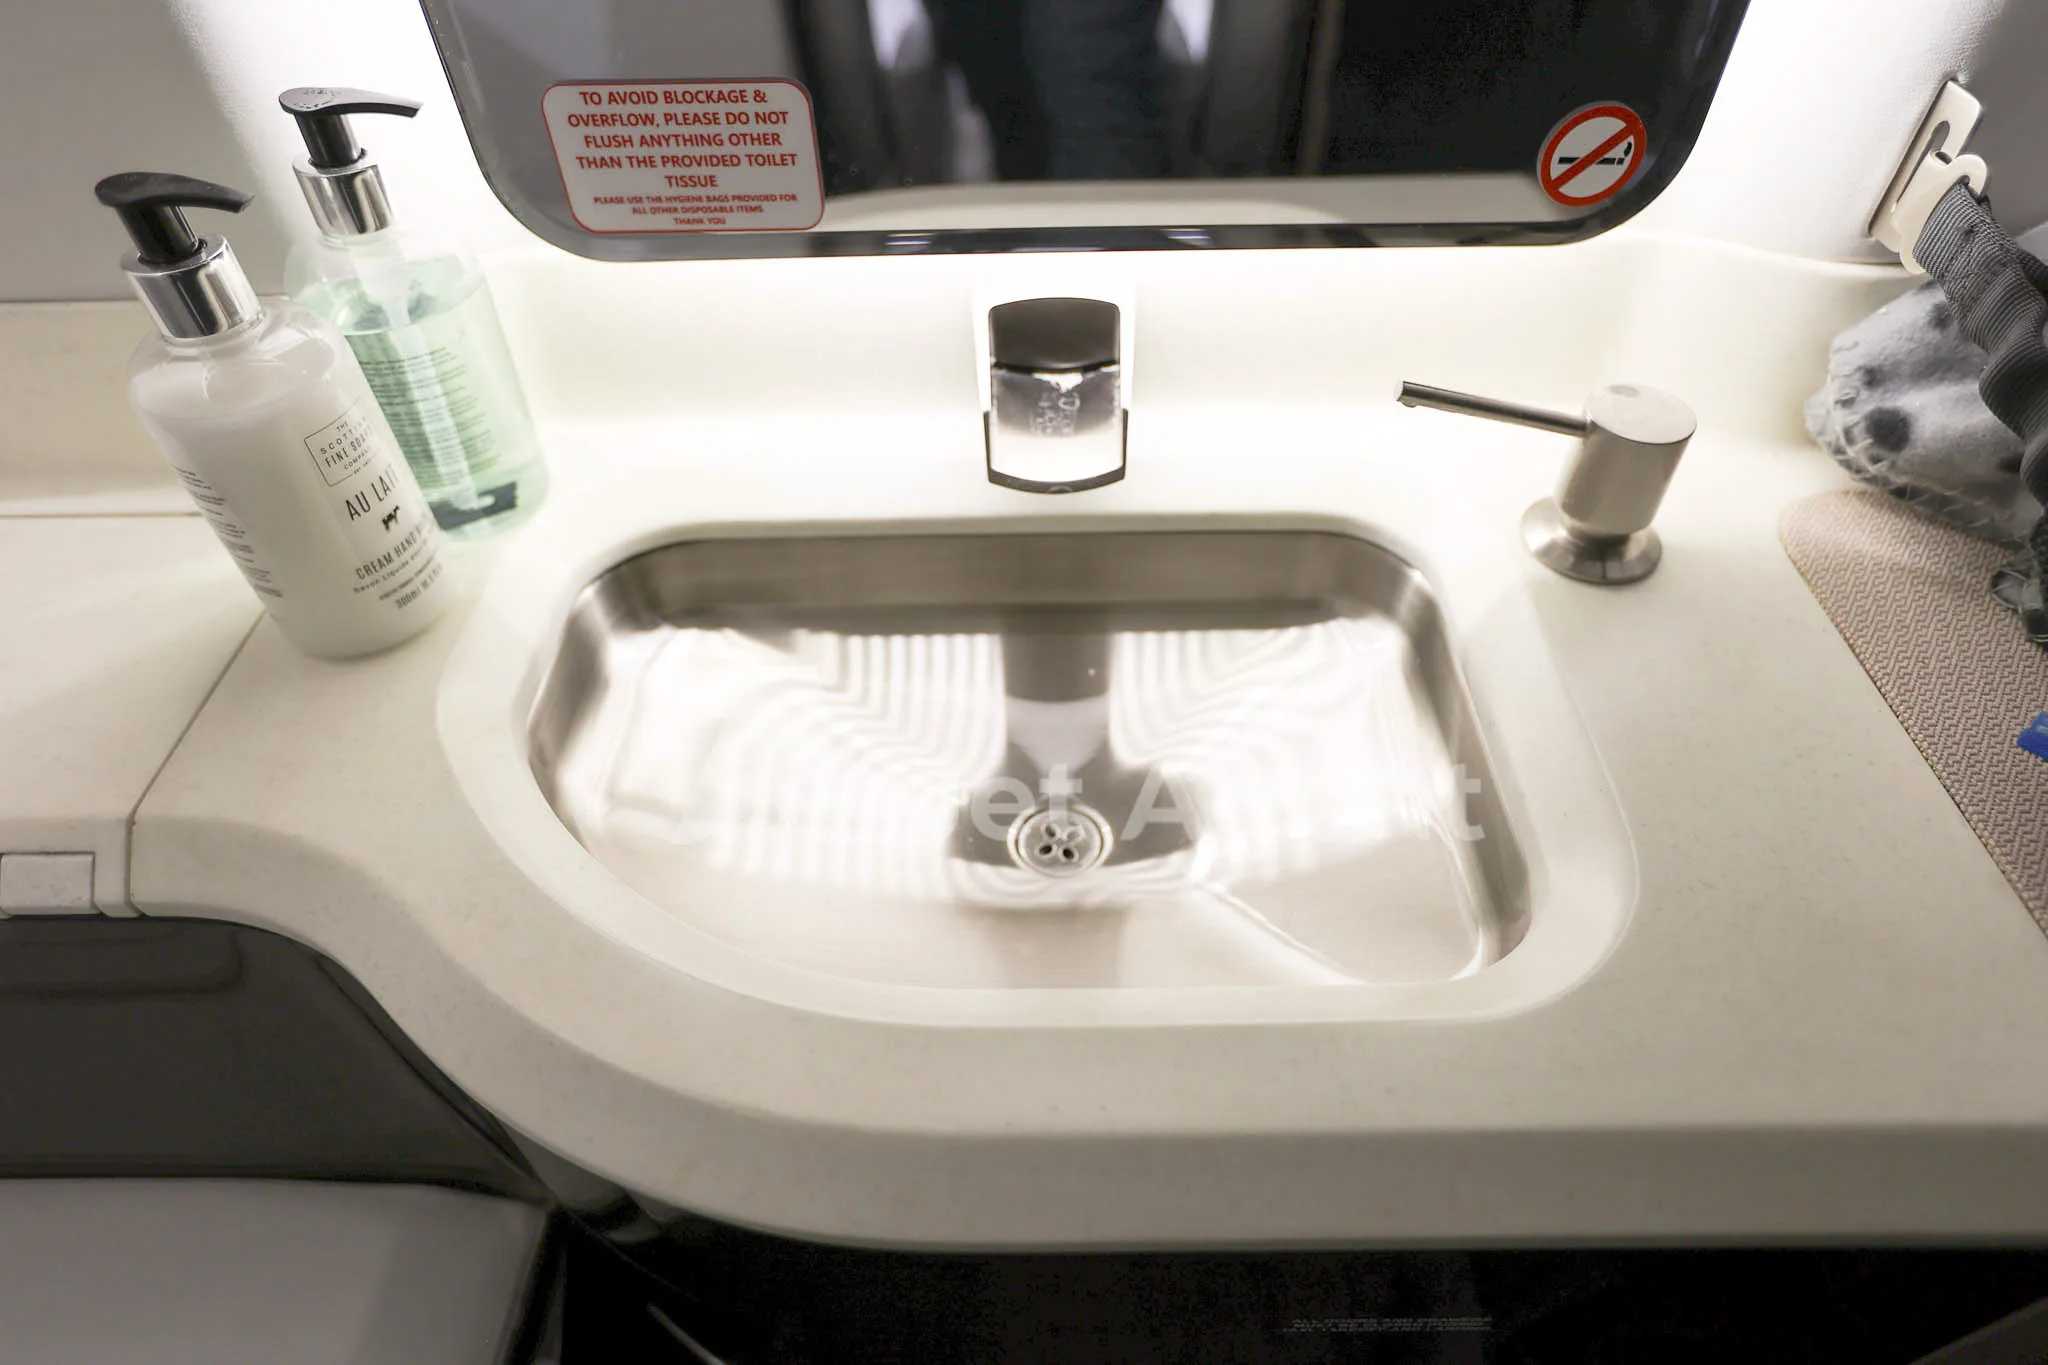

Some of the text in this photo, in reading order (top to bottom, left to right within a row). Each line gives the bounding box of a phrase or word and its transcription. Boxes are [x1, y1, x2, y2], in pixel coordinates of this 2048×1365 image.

[579, 89, 767, 105] TO AVOID BLOCKAGE &
[568, 111, 788, 128] OVERFLOW, PLEASE DO NOT
[584, 132, 782, 148] FLUSH ANYTHING OTHER
[576, 153, 798, 169] THAN THE PROVIDED TOILET
[665, 175, 718, 188] TISSUE
[593, 193, 797, 205] PLEASE USE THE HYGIENE BAGS PROVIDED FOR
[632, 205, 764, 215] ALL OTHER DISPOSABLE ITEMS
[673, 217, 727, 225] THANK YOU
[325, 447, 349, 468] FINE
[345, 491, 371, 521] AU
[371, 463, 400, 502] LAIT
[355, 552, 393, 580] CREAM
